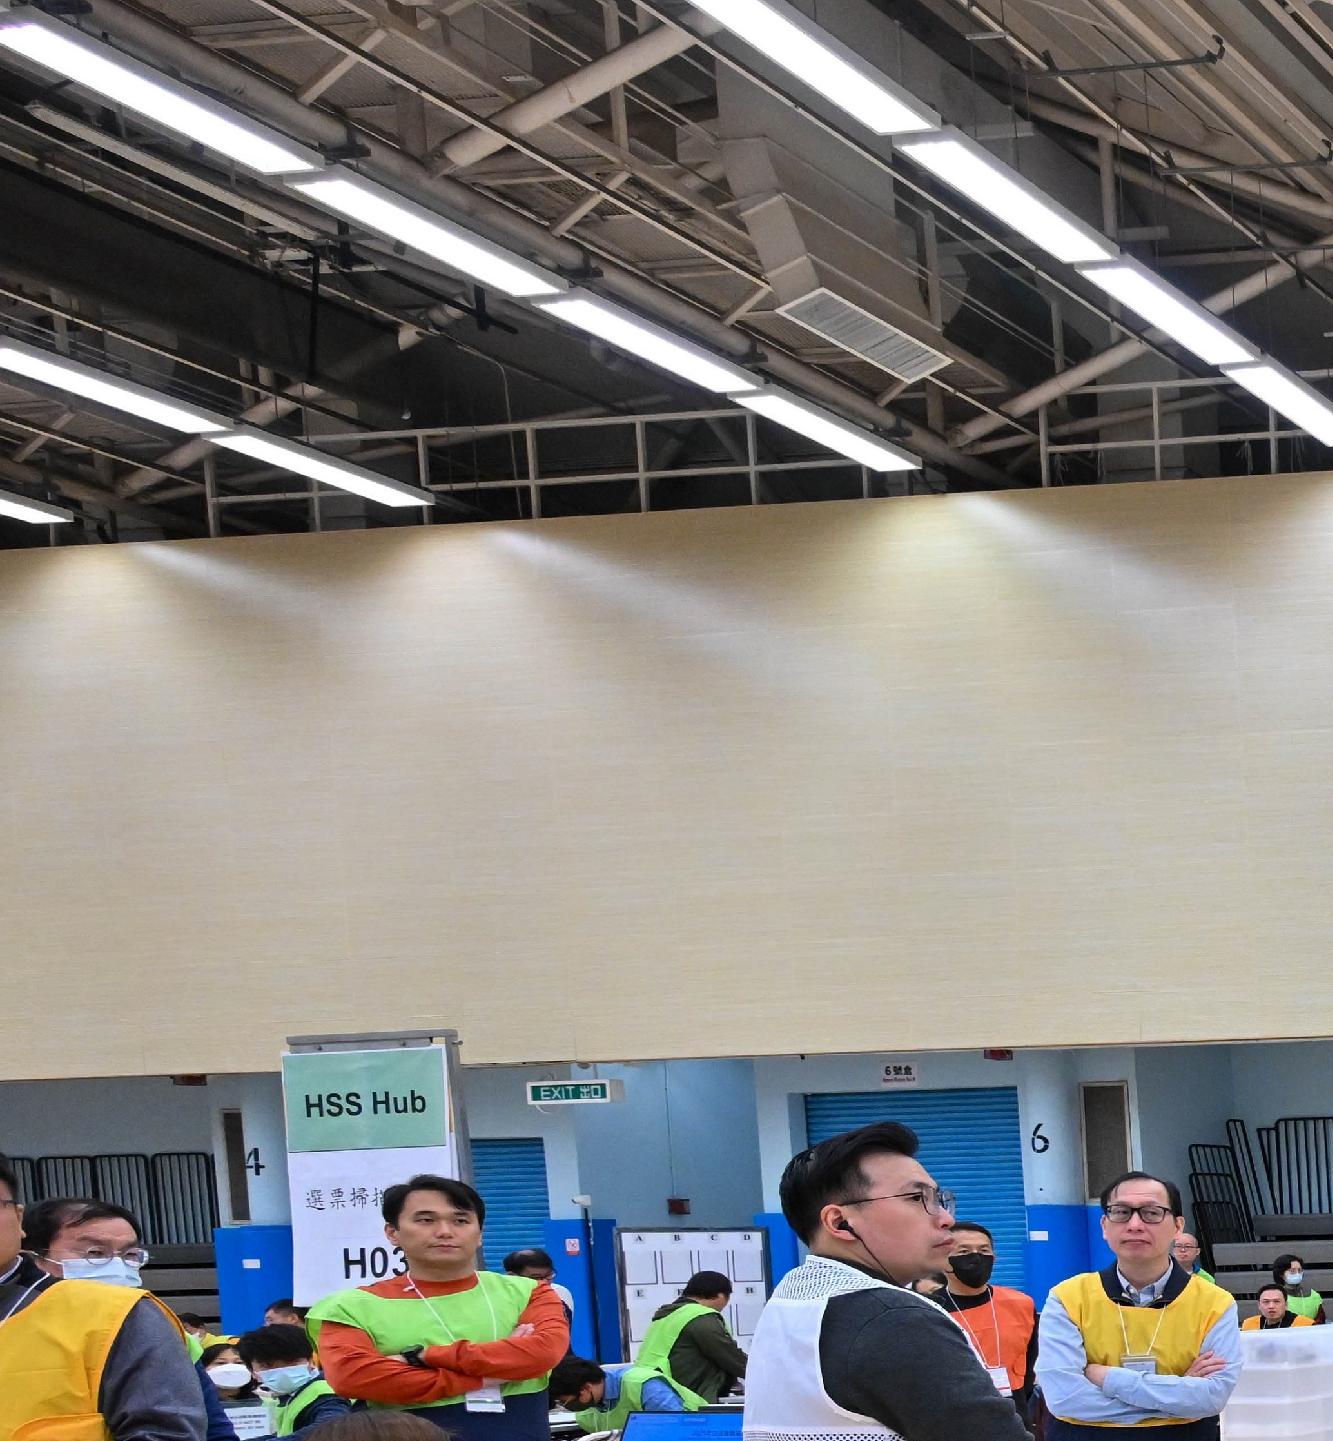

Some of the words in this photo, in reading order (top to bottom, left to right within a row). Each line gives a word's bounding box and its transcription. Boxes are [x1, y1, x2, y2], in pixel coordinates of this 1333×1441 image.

[304, 1092, 362, 1117] HSS
[372, 1090, 426, 1114] Hub
[541, 1086, 575, 1100] EXIT
[580, 1085, 601, 1099] 出口
[1031, 1123, 1049, 1153] 6
[246, 1147, 265, 1176] 4
